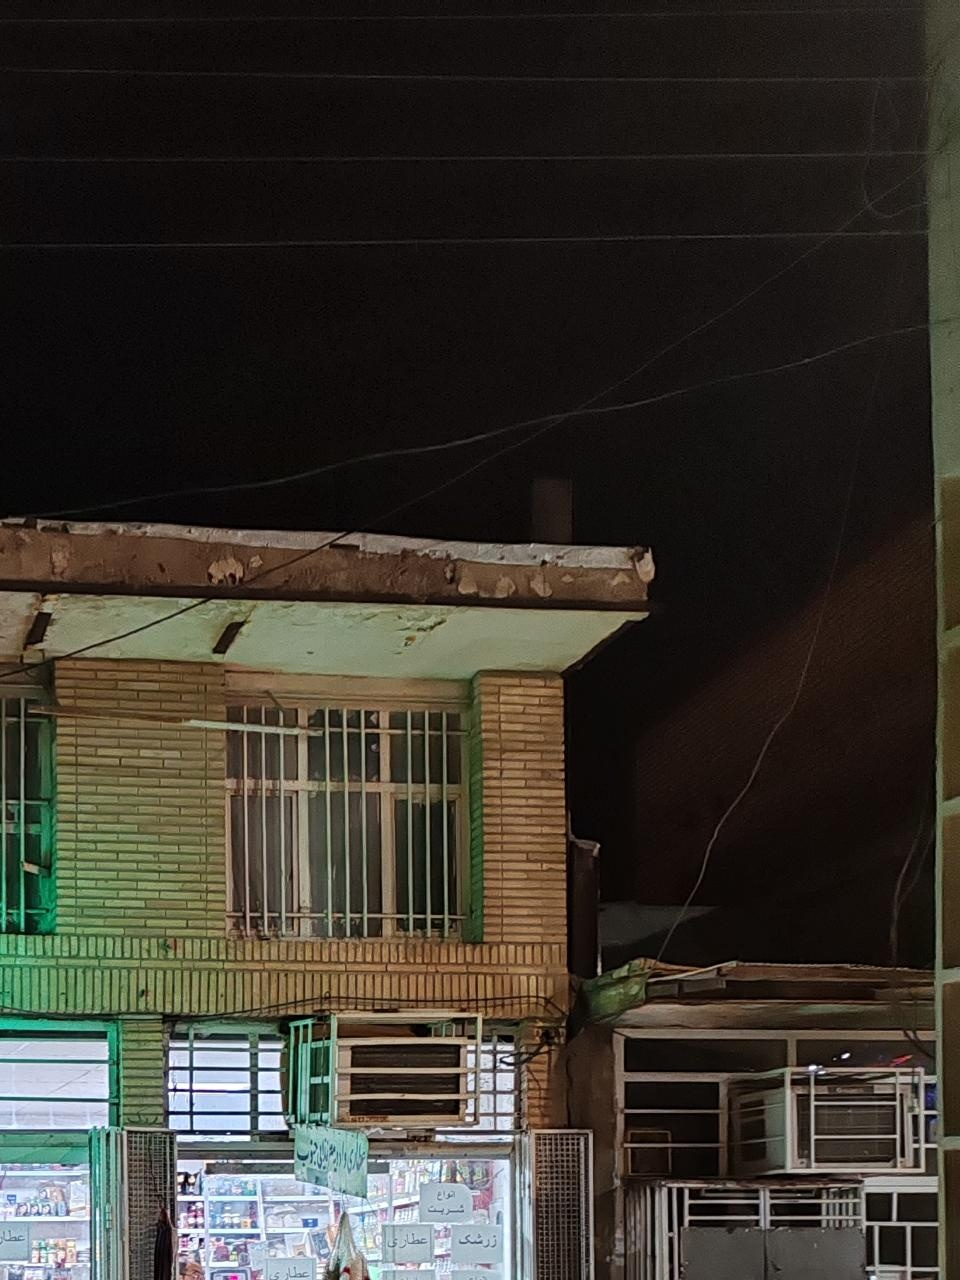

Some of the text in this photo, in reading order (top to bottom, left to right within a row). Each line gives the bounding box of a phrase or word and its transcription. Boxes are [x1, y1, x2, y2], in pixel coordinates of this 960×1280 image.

[296, 1139, 318, 1168] جنوب
[436, 1190, 456, 1201] انواع
[427, 1205, 465, 1215] شربت
[387, 1233, 428, 1248] عطاری
[458, 1233, 497, 1248] زرشک
